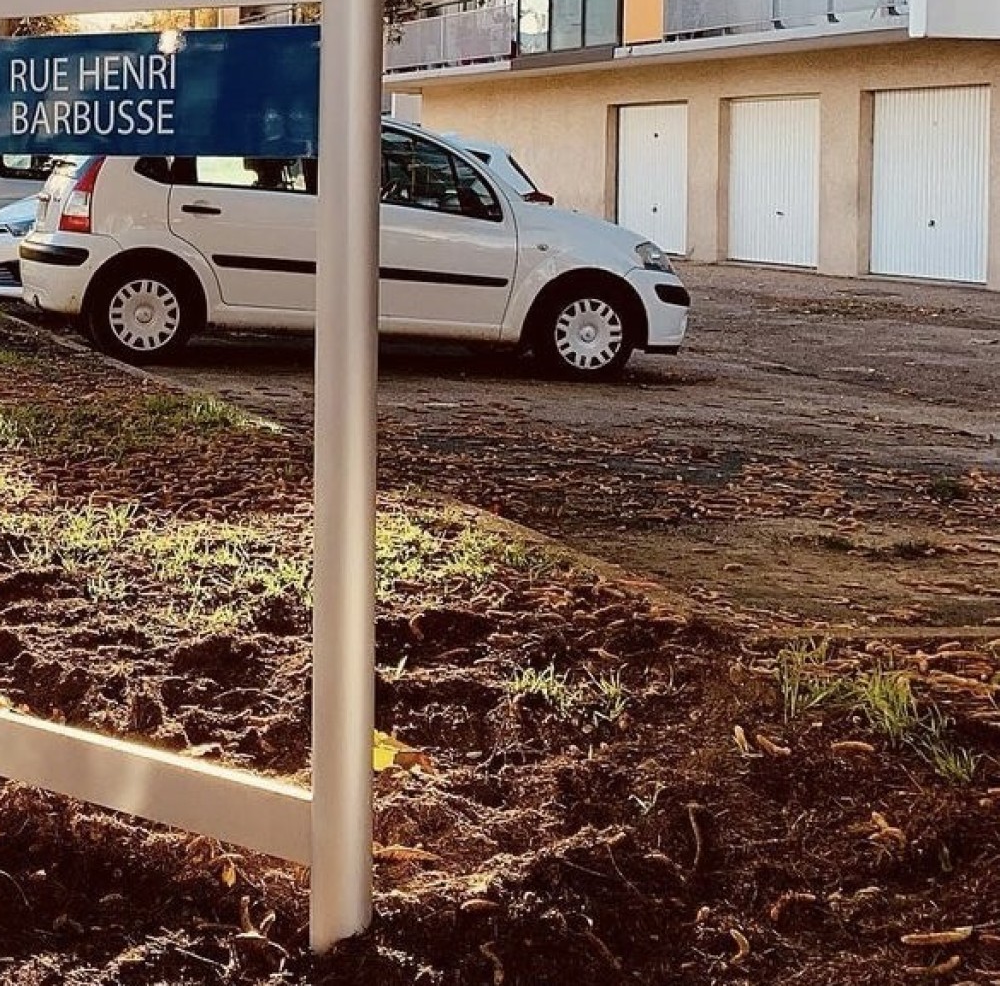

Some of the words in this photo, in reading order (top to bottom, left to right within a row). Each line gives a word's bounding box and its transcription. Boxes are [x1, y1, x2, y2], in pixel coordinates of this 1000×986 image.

[10, 57, 68, 93] RUE
[79, 53, 176, 91] HENRI
[12, 99, 174, 136] BARBUSSE
